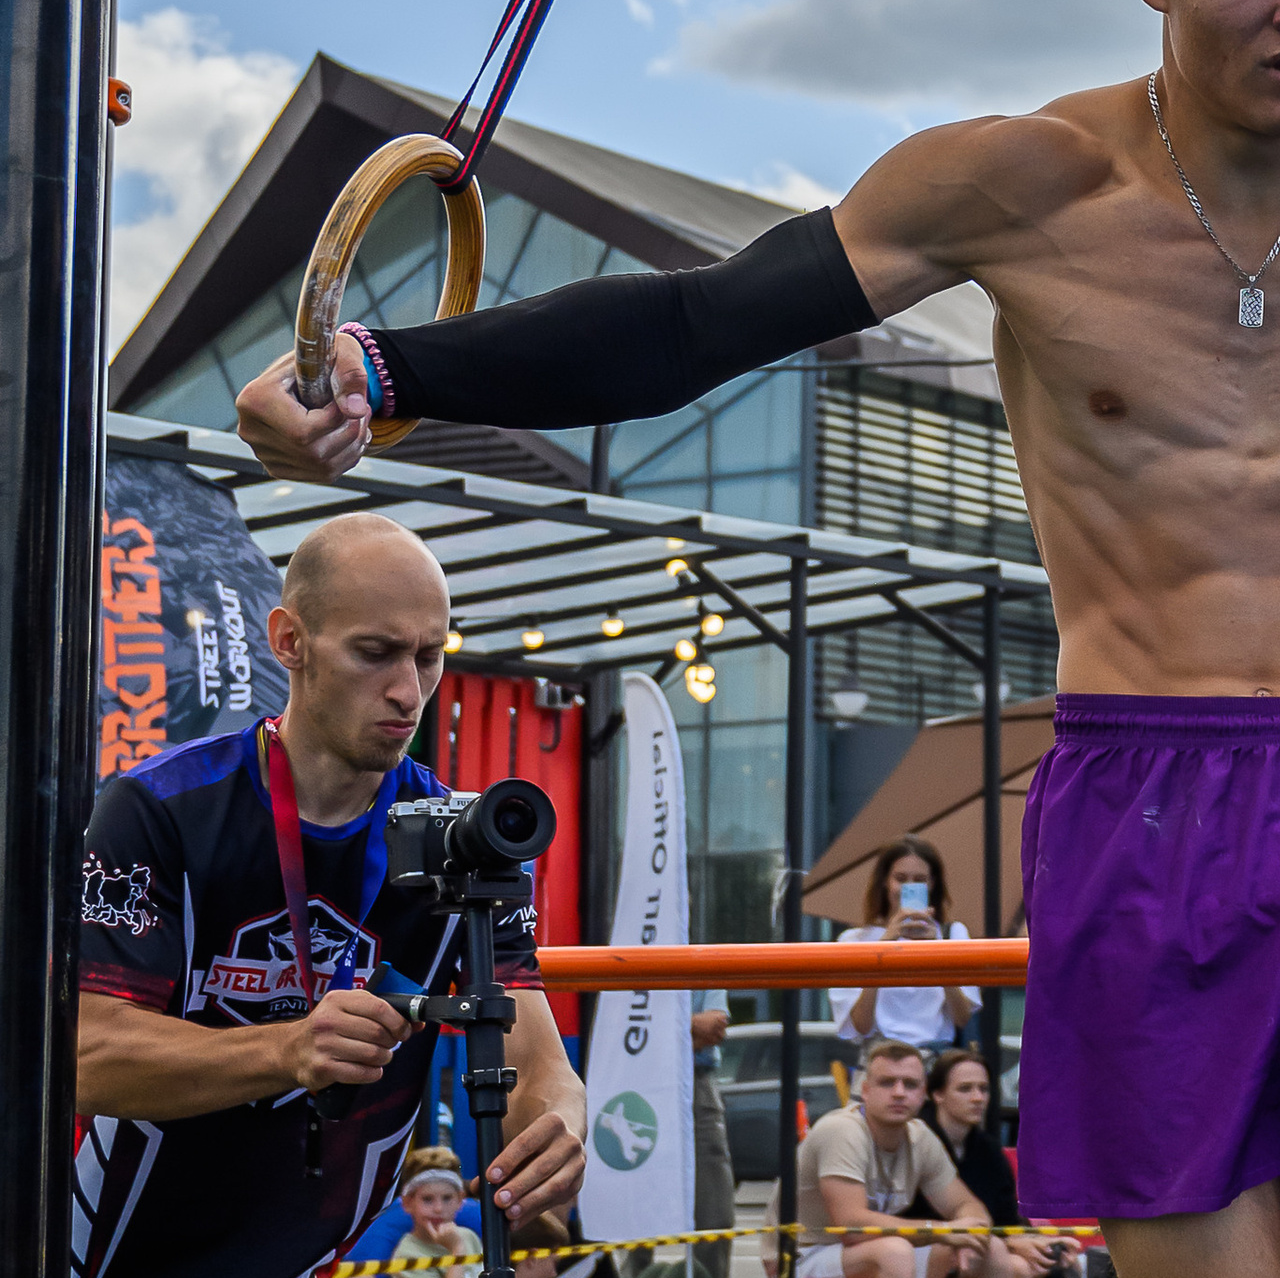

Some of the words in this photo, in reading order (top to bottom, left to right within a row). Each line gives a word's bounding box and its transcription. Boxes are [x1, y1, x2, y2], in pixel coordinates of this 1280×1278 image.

[193, 611, 221, 709] STREET
[215, 580, 252, 711] WORKOUT
[207, 964, 271, 994] STEEL
